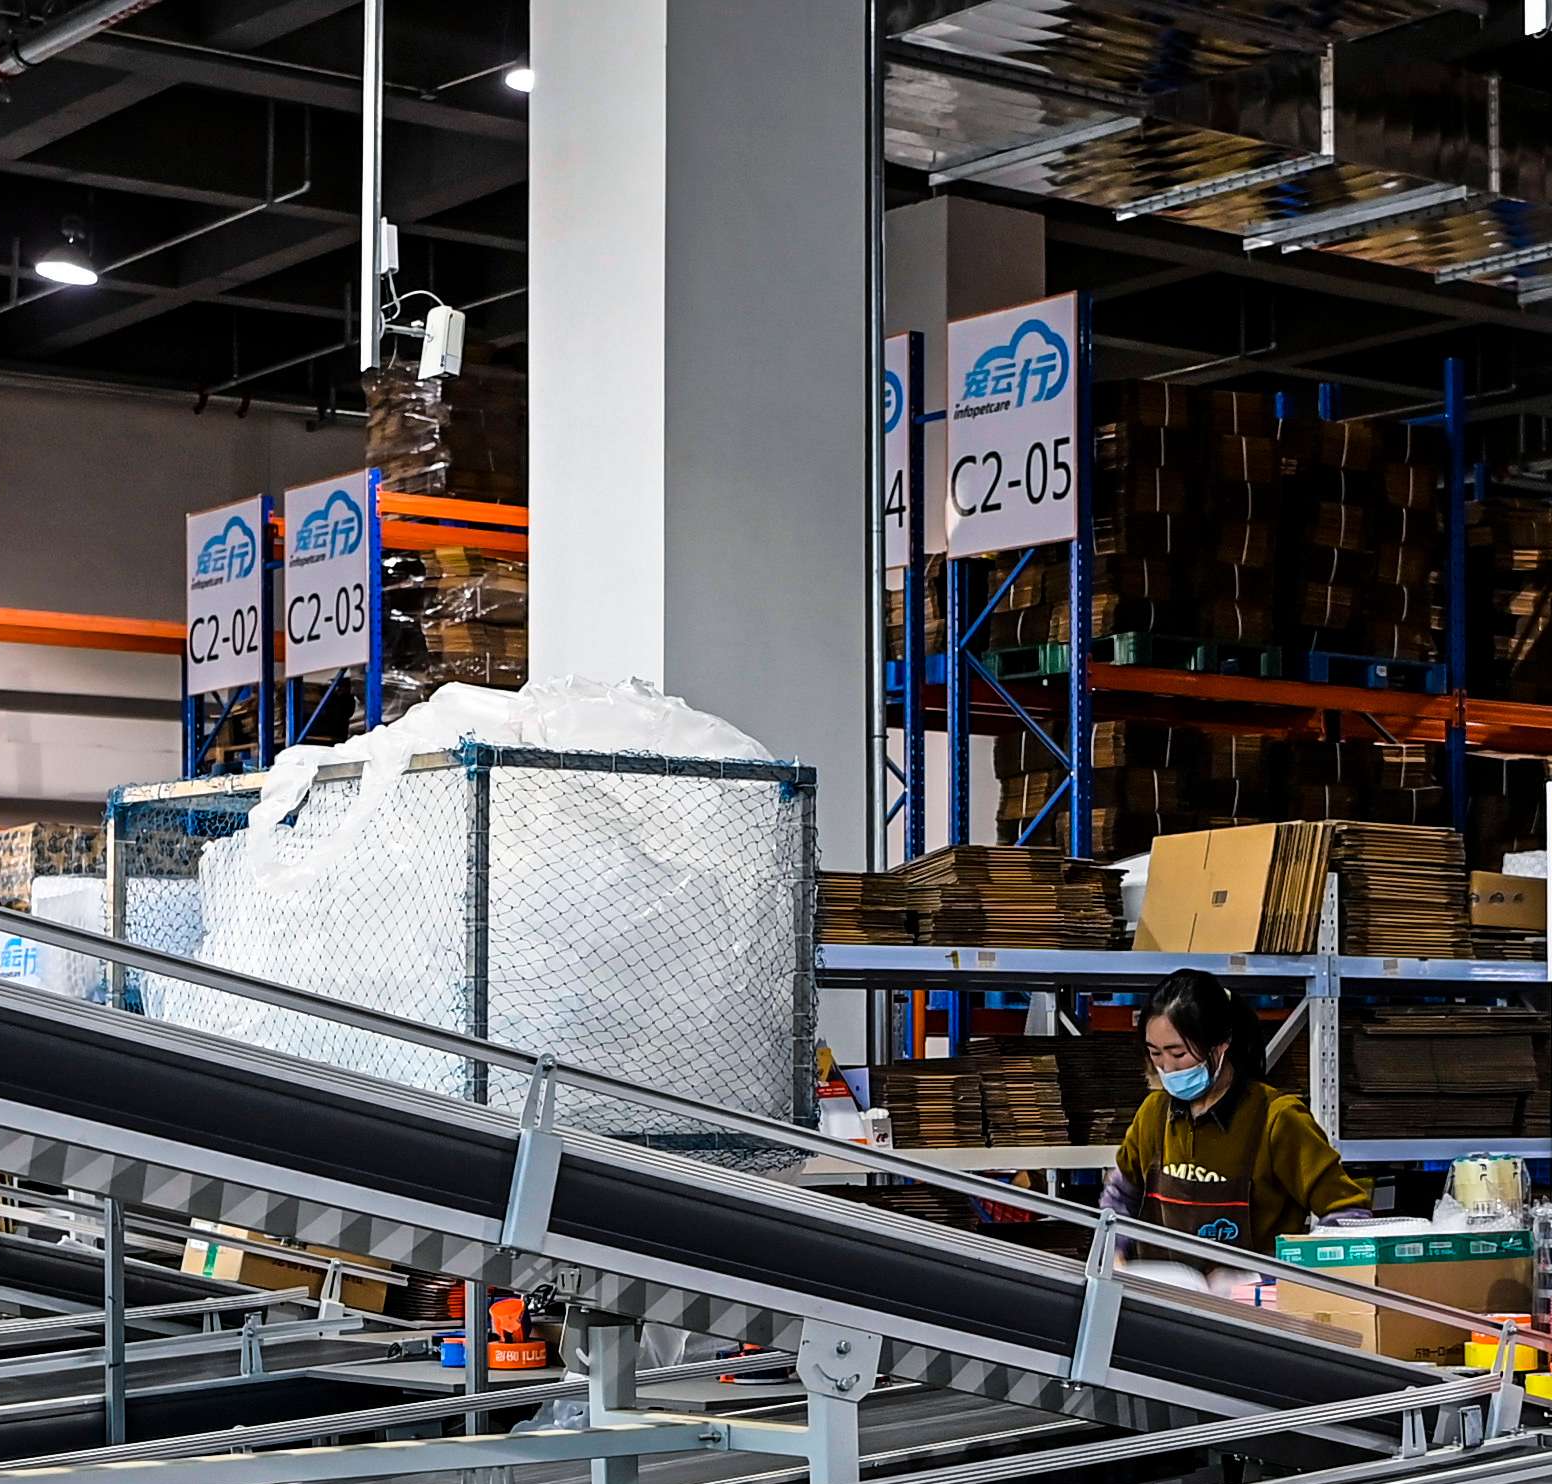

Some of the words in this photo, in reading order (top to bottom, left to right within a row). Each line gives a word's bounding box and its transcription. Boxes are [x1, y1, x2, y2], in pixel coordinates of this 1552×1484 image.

[953, 400, 1011, 420] infopetcare
[950, 436, 1072, 518] C2-05
[189, 604, 259, 665] C2-02
[286, 583, 365, 645] C2-03
[1162, 1163, 1228, 1183] MESO
